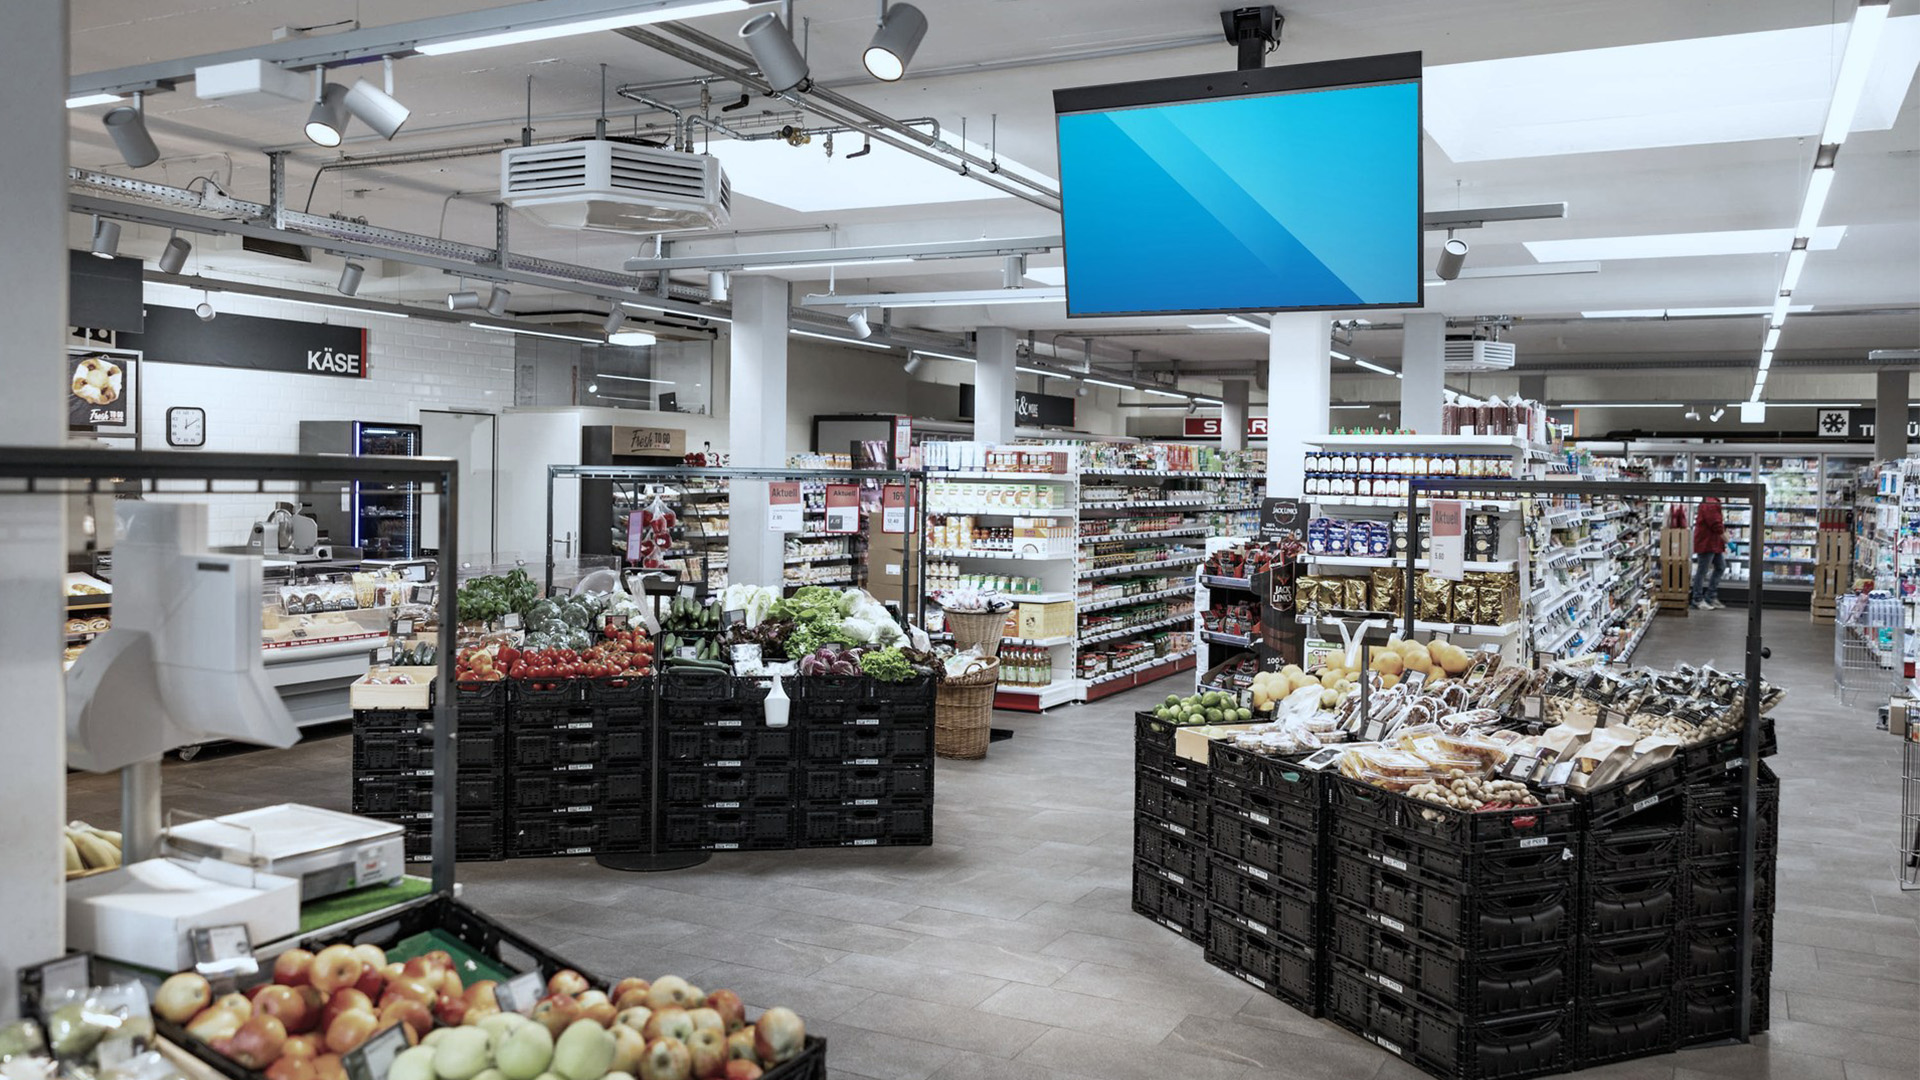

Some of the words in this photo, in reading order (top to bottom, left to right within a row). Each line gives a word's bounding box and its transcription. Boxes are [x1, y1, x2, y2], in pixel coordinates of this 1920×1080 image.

[307, 347, 359, 374] KÄSE
[1019, 395, 1029, 415] &
[89, 408, 109, 420] Fresh
[1204, 421, 1267, 433] SR
[631, 429, 653, 448] Fresh
[655, 432, 662, 443] TO
[663, 433, 671, 444] GO
[771, 488, 798, 498] Aktuell
[1435, 510, 1458, 525] Aktuell
[1274, 586, 1291, 595] JACK
